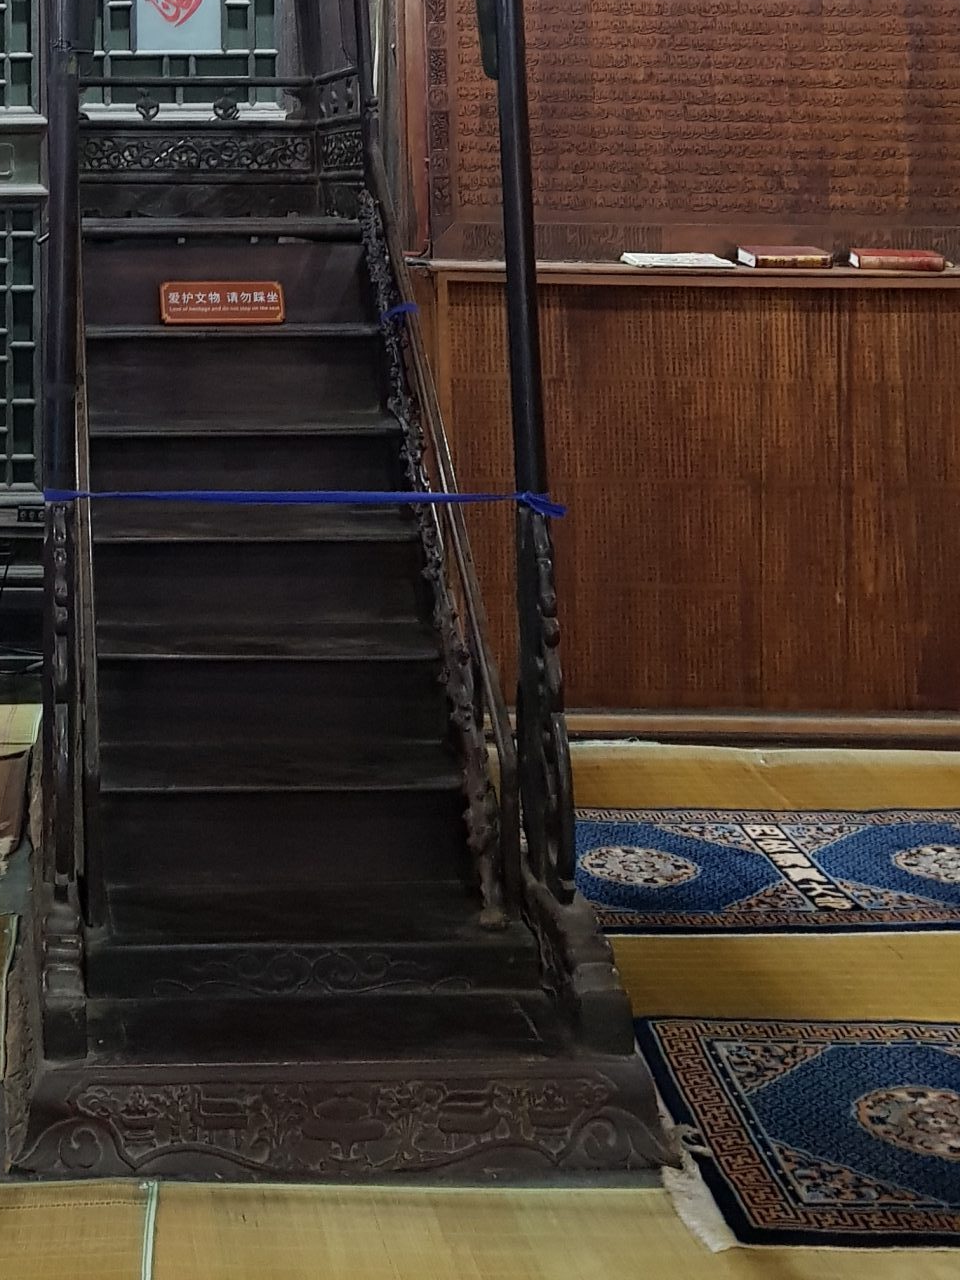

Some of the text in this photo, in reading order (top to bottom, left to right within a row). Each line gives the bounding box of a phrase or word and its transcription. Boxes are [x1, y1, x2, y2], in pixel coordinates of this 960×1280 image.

[168, 291, 279, 304] 爱护文物 请勿踩坐
